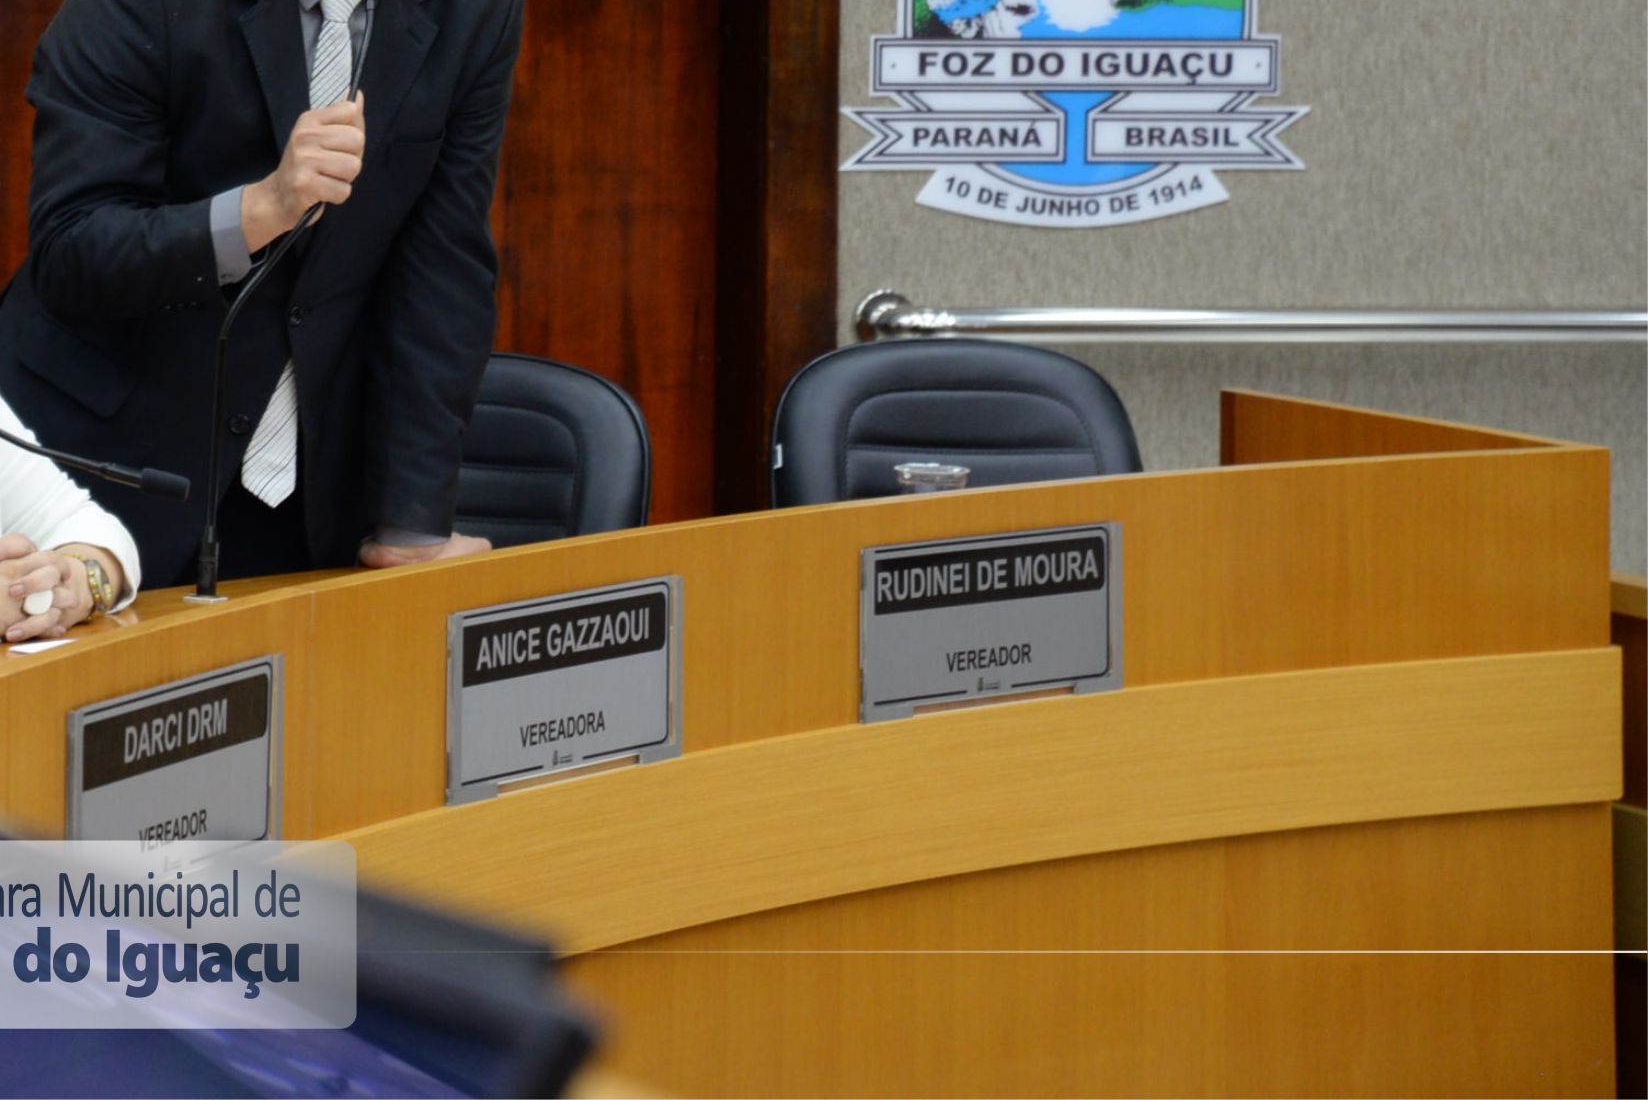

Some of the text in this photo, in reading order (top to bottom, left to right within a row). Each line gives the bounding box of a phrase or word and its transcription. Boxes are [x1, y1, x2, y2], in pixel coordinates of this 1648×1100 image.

[917, 51, 1234, 86] FOZ DO IGUAÇU
[912, 121, 1042, 148] PARANÁ
[1124, 126, 1239, 148] BRASIL
[944, 175, 1203, 217] 10 DE JUNHO DE 1914
[877, 549, 1099, 603] RUDINEI DE MOURA
[476, 607, 650, 671] ANICE GAZZAOUI
[946, 643, 1032, 673] VEREADOR
[124, 698, 228, 764] DARCI DRM
[520, 710, 606, 748] VEREADORA
[139, 808, 207, 853] VEREADOR
